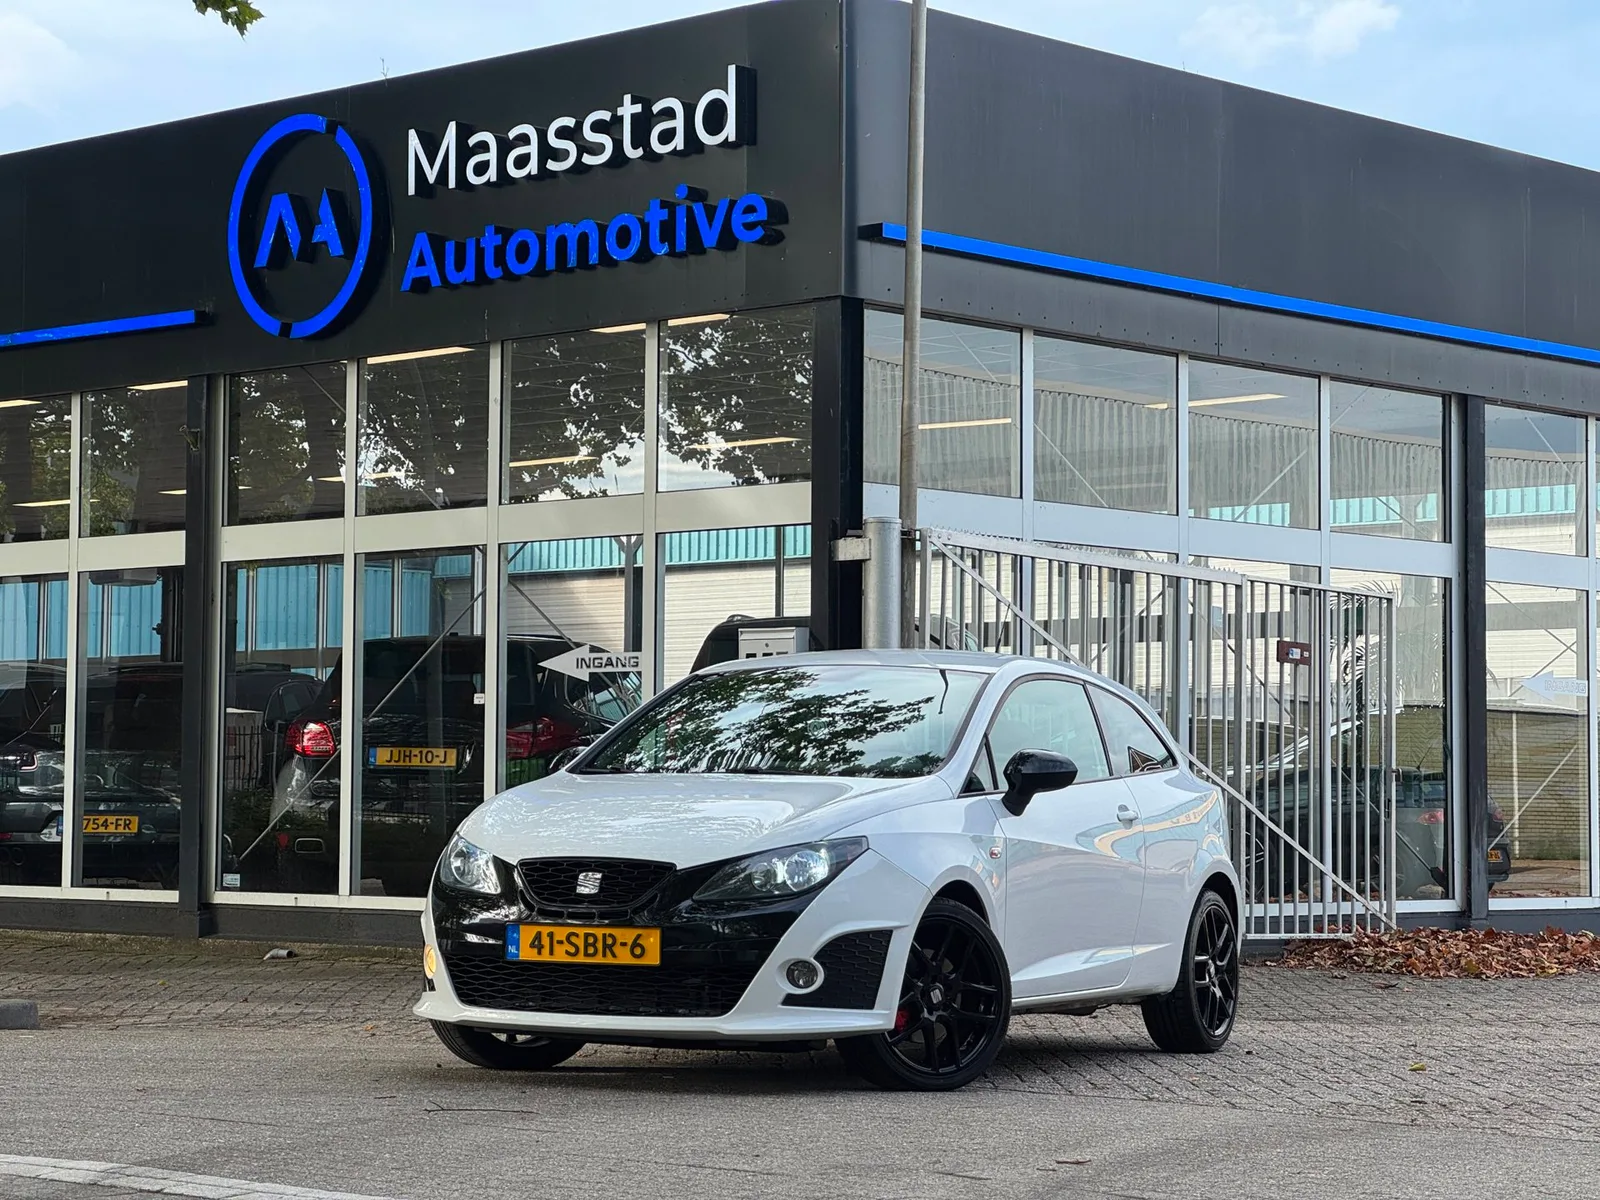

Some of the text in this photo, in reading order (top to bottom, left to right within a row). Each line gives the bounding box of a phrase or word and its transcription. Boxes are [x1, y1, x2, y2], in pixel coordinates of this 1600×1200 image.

[408, 63, 737, 196] Maasstad
[400, 183, 768, 292] Automotive
[575, 656, 640, 670] INGANG
[385, 749, 447, 764] JJH-10-J
[508, 945, 518, 954] NL
[528, 930, 646, 959] 41-SBR-6
